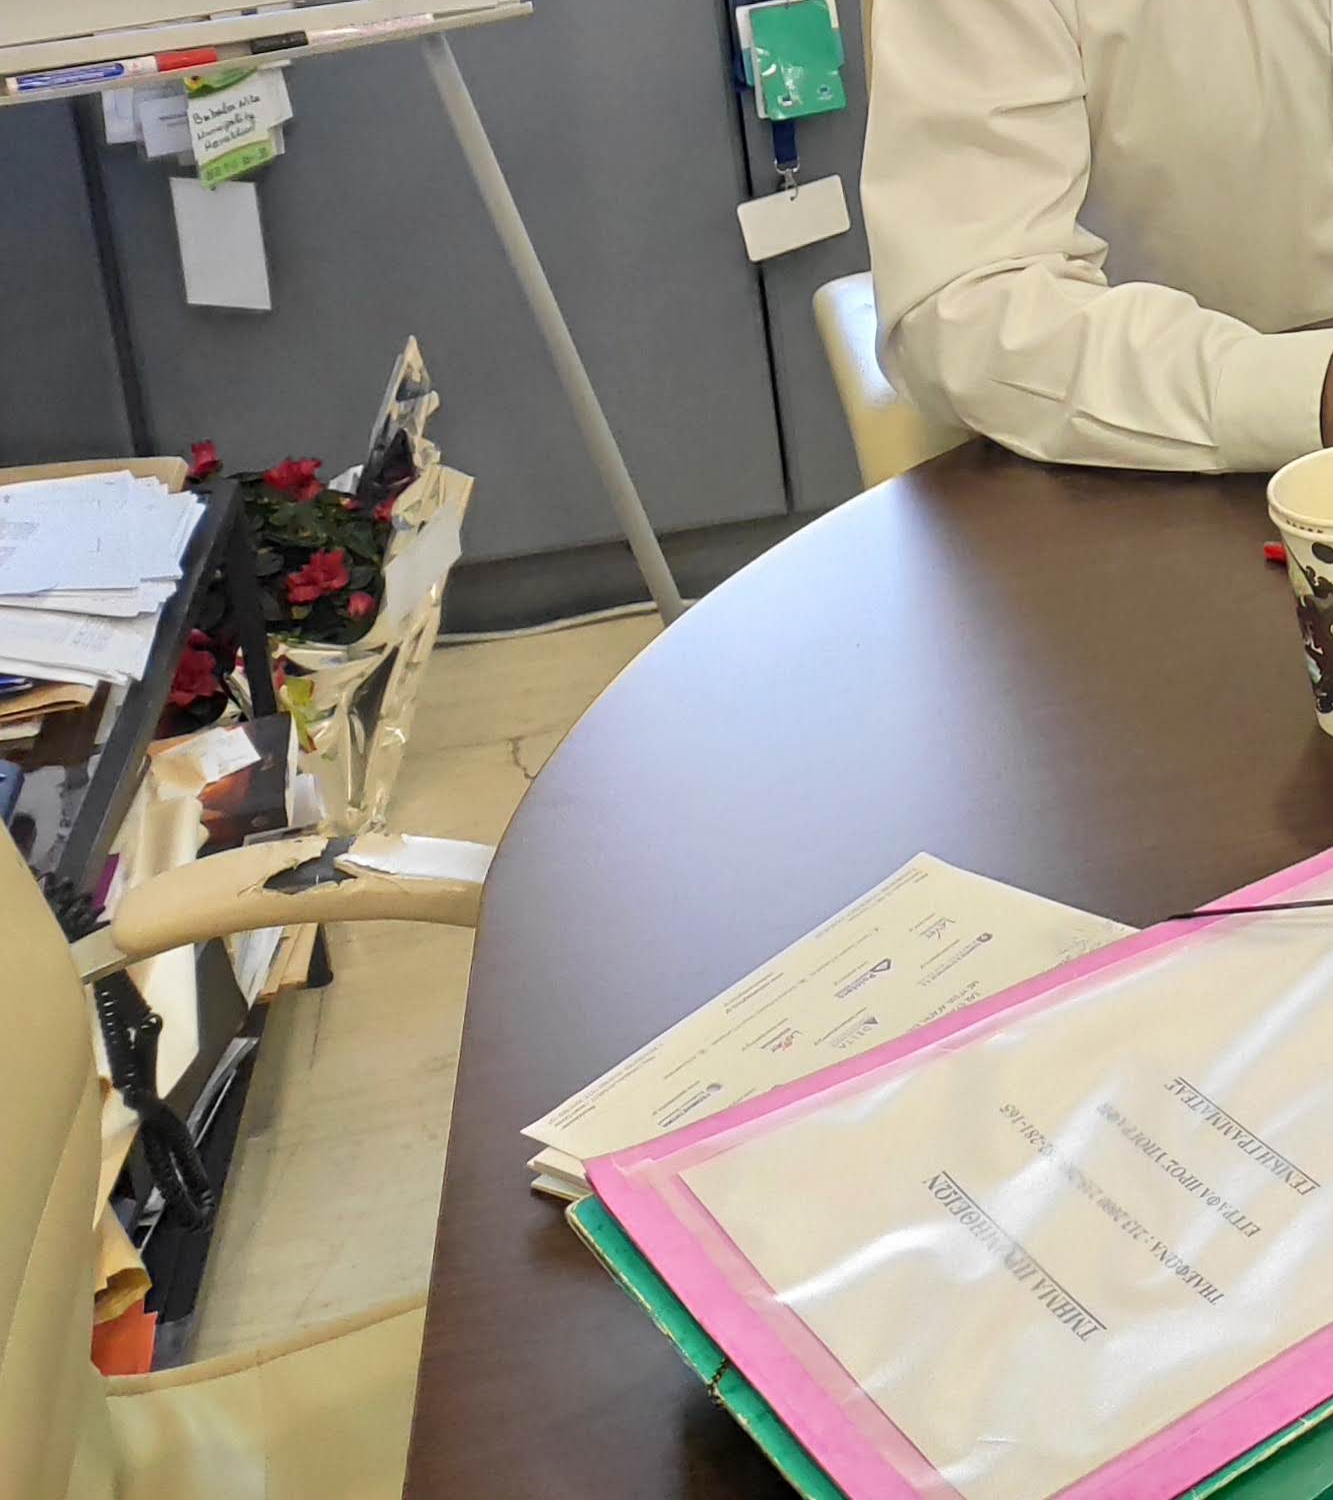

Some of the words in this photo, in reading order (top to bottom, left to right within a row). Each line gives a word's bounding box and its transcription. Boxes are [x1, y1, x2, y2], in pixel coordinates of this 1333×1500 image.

[1162, 1159, 1203, 1191] ΠΡΟΣ
[1198, 1185, 1261, 1238] ΕΓΓΡΑΦΑ
[1147, 1238, 1225, 1306] ΤΗΛΕΦΩΝΑ
[1034, 1273, 1098, 1342] ΤΜΗΜΑ
